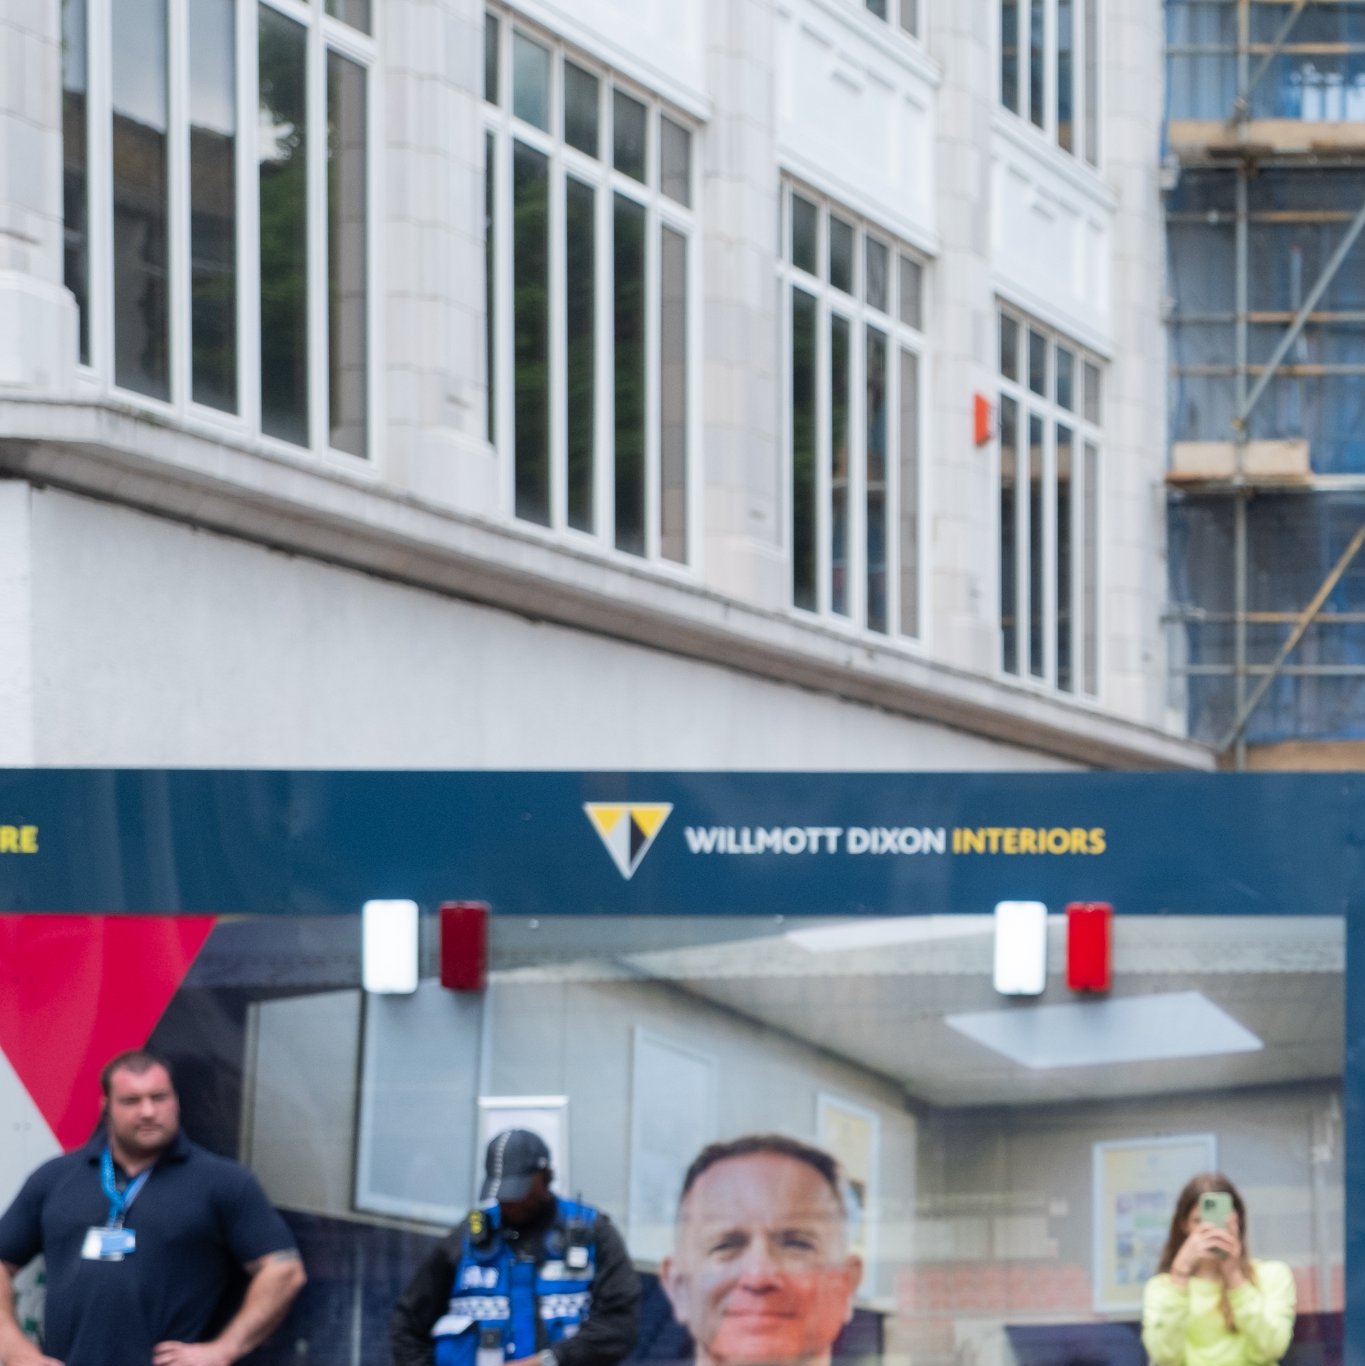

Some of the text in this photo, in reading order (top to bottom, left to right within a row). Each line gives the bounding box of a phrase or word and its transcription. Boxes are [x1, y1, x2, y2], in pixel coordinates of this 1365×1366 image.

[684, 826, 1107, 855] WILLMOTT DIXON INTERIORS
